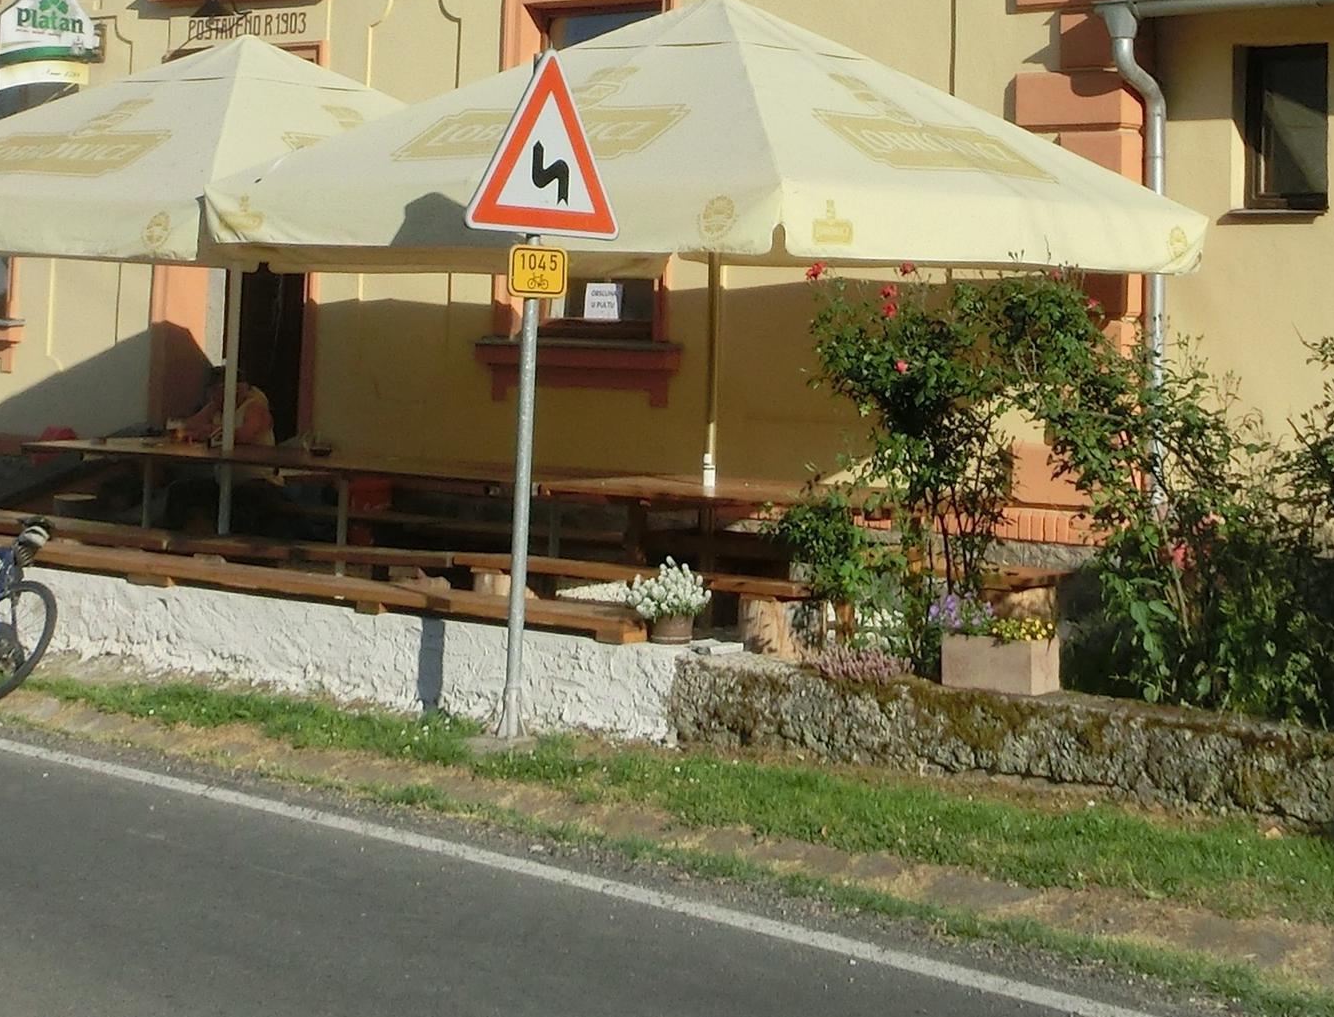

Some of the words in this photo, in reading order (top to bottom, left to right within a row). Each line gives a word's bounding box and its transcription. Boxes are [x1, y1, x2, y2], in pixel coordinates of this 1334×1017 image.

[16, 6, 85, 34] Platan
[275, 12, 307, 35] 1903
[520, 253, 558, 271] 1045
